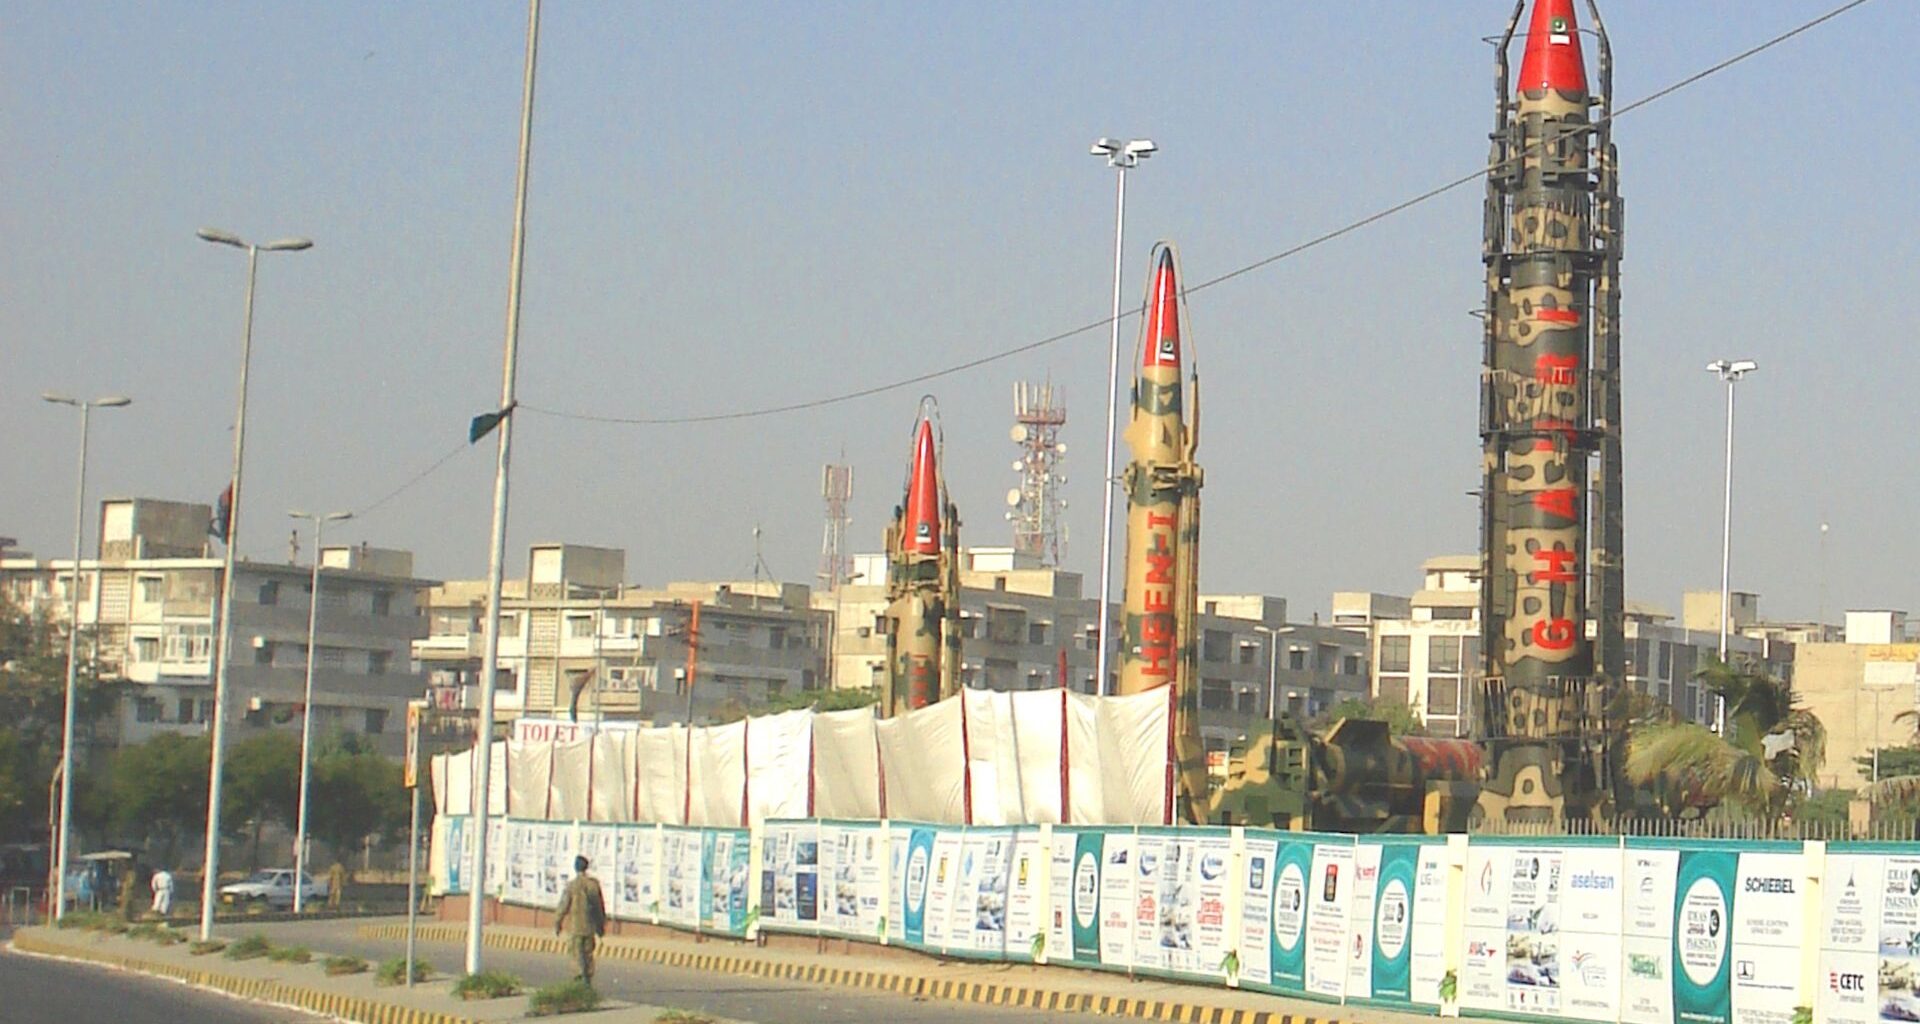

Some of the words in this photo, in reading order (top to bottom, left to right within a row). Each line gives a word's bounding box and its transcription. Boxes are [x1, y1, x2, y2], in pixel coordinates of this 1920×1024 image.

[1571, 869, 1615, 889] aselsan
[1745, 876, 1796, 894] SCHIEBEL
[1840, 973, 1865, 991] CETC
